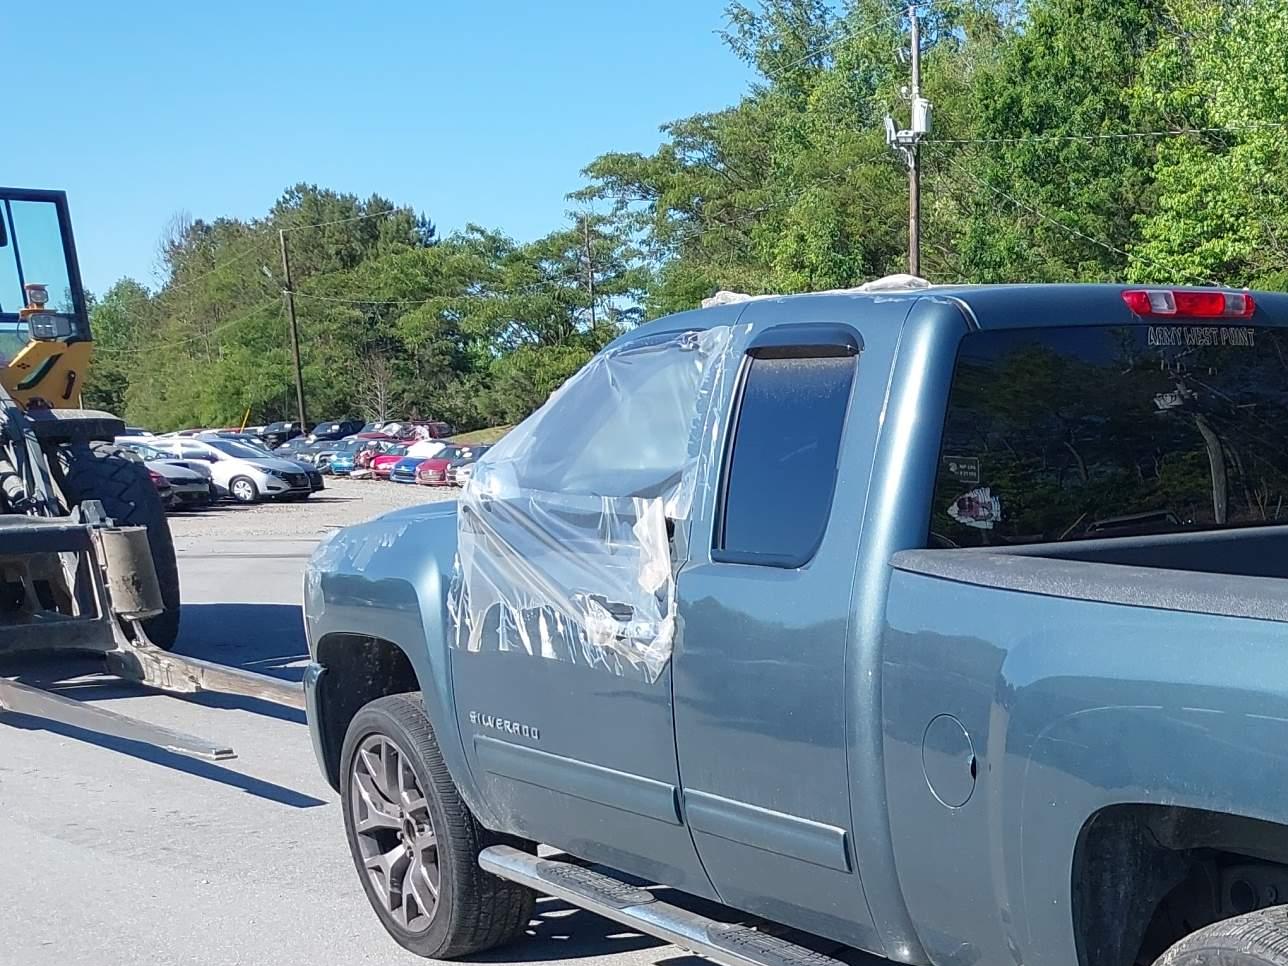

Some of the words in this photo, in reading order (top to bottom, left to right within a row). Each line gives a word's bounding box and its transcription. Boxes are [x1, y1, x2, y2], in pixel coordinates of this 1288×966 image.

[1148, 327, 1182, 346] ARMY
[1183, 327, 1219, 346] WEST
[1220, 328, 1255, 347] POINT
[469, 710, 540, 740] SILVERADO
